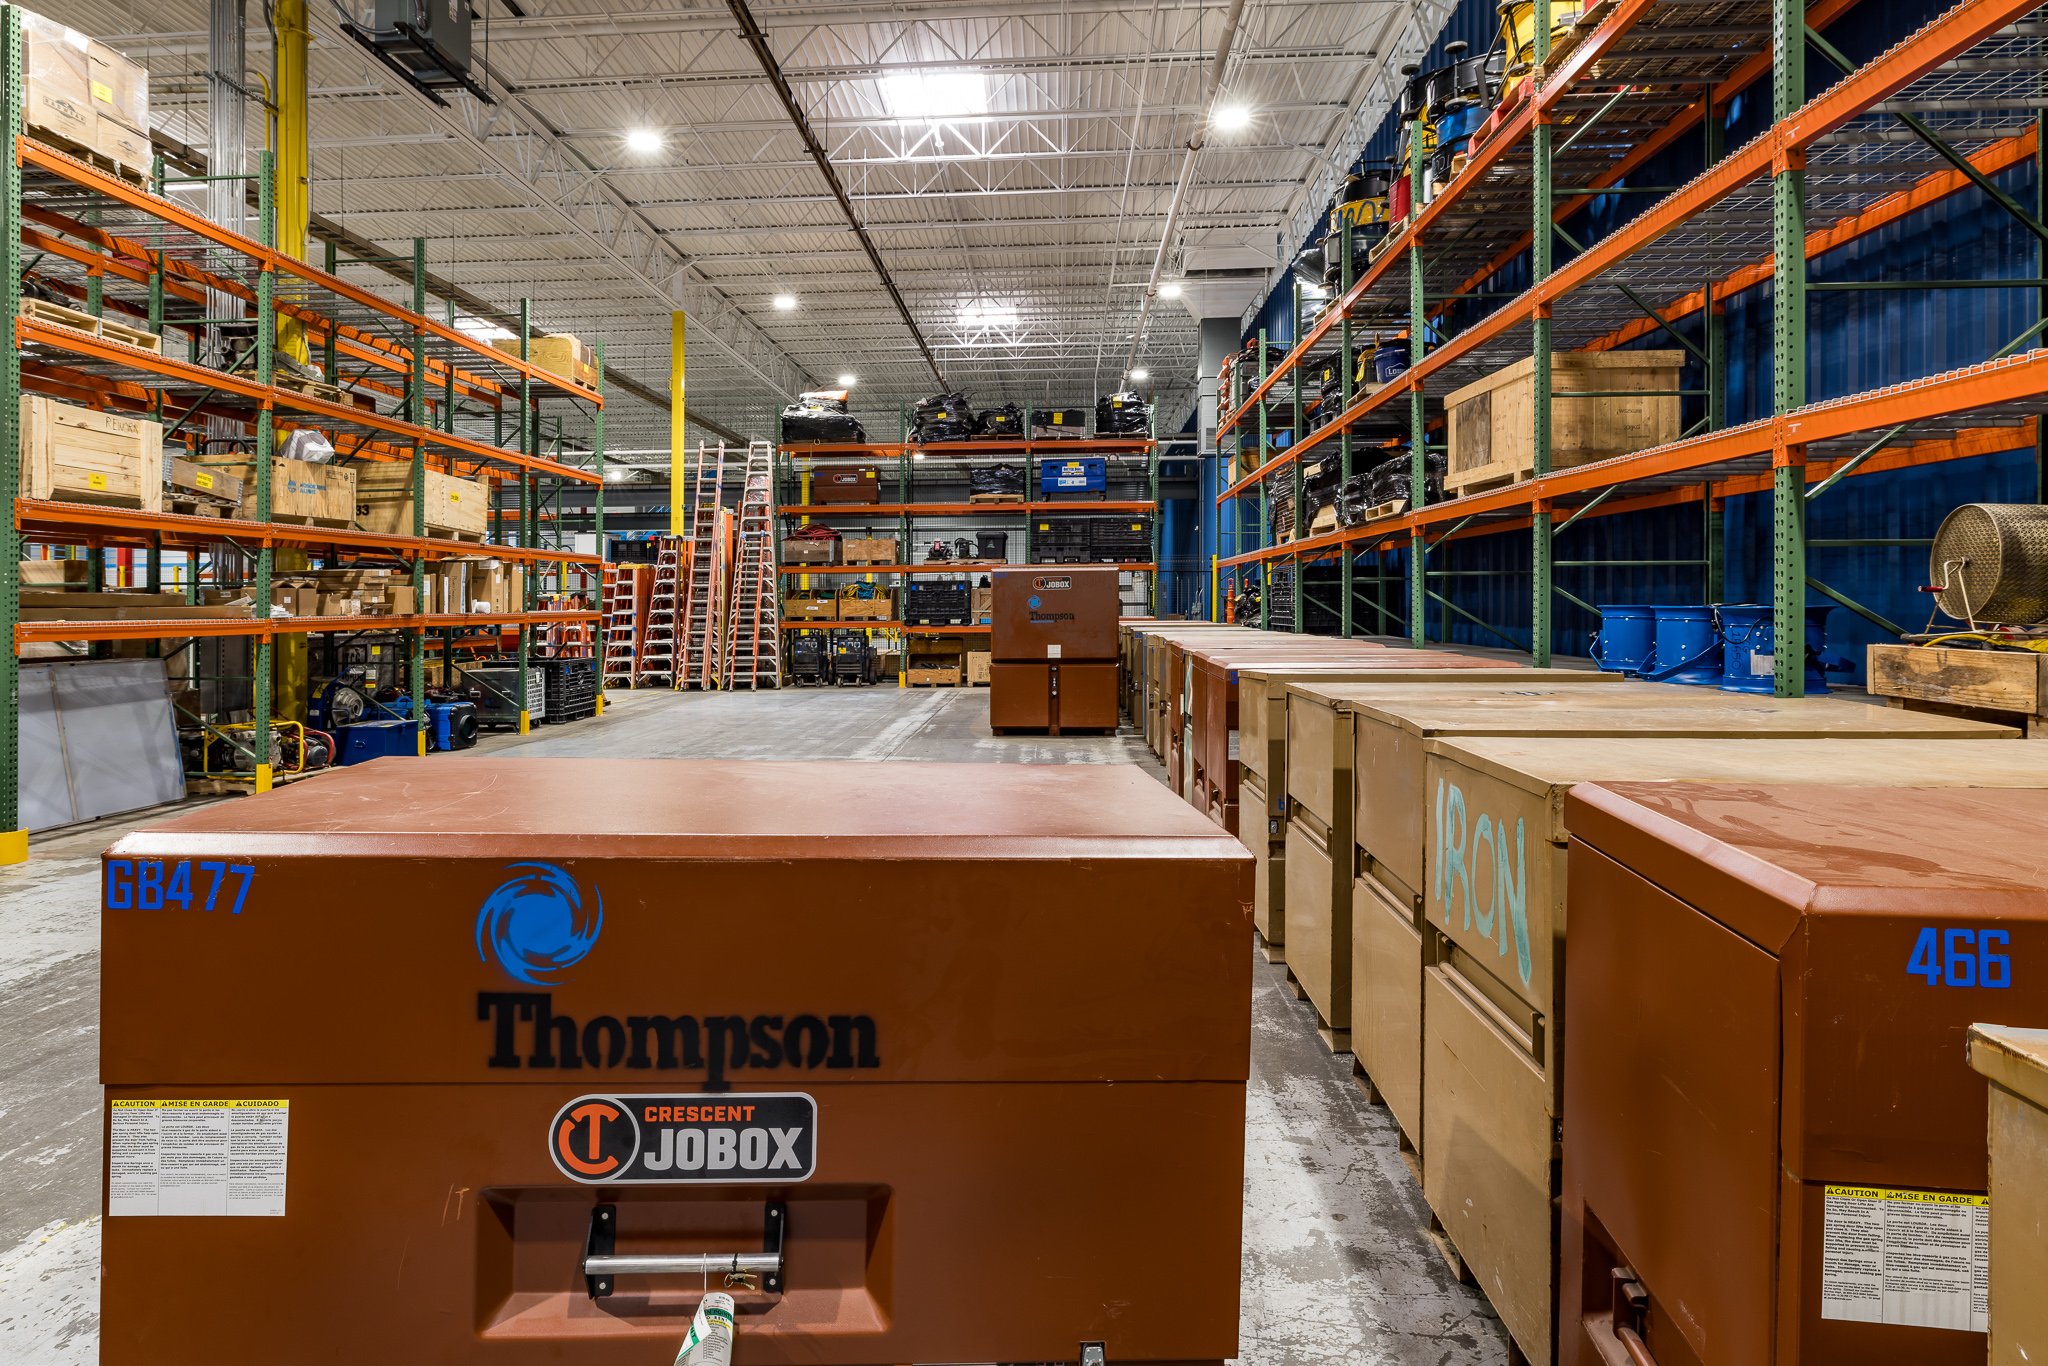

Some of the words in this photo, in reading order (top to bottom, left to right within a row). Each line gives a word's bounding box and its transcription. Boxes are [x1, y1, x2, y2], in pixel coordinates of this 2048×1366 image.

[1046, 580, 1070, 588] JOBOX
[1029, 611, 1075, 623] Thompson
[107, 860, 255, 914] GB477
[1435, 777, 1531, 985] IRON
[1906, 927, 2011, 989] 466
[477, 991, 881, 1092] Thompson
[644, 1105, 756, 1123] CRESCENT
[643, 1127, 803, 1171] JOBOX
[1834, 1188, 1879, 1198] CAUTION
[1938, 1195, 1972, 1204] GARDE
